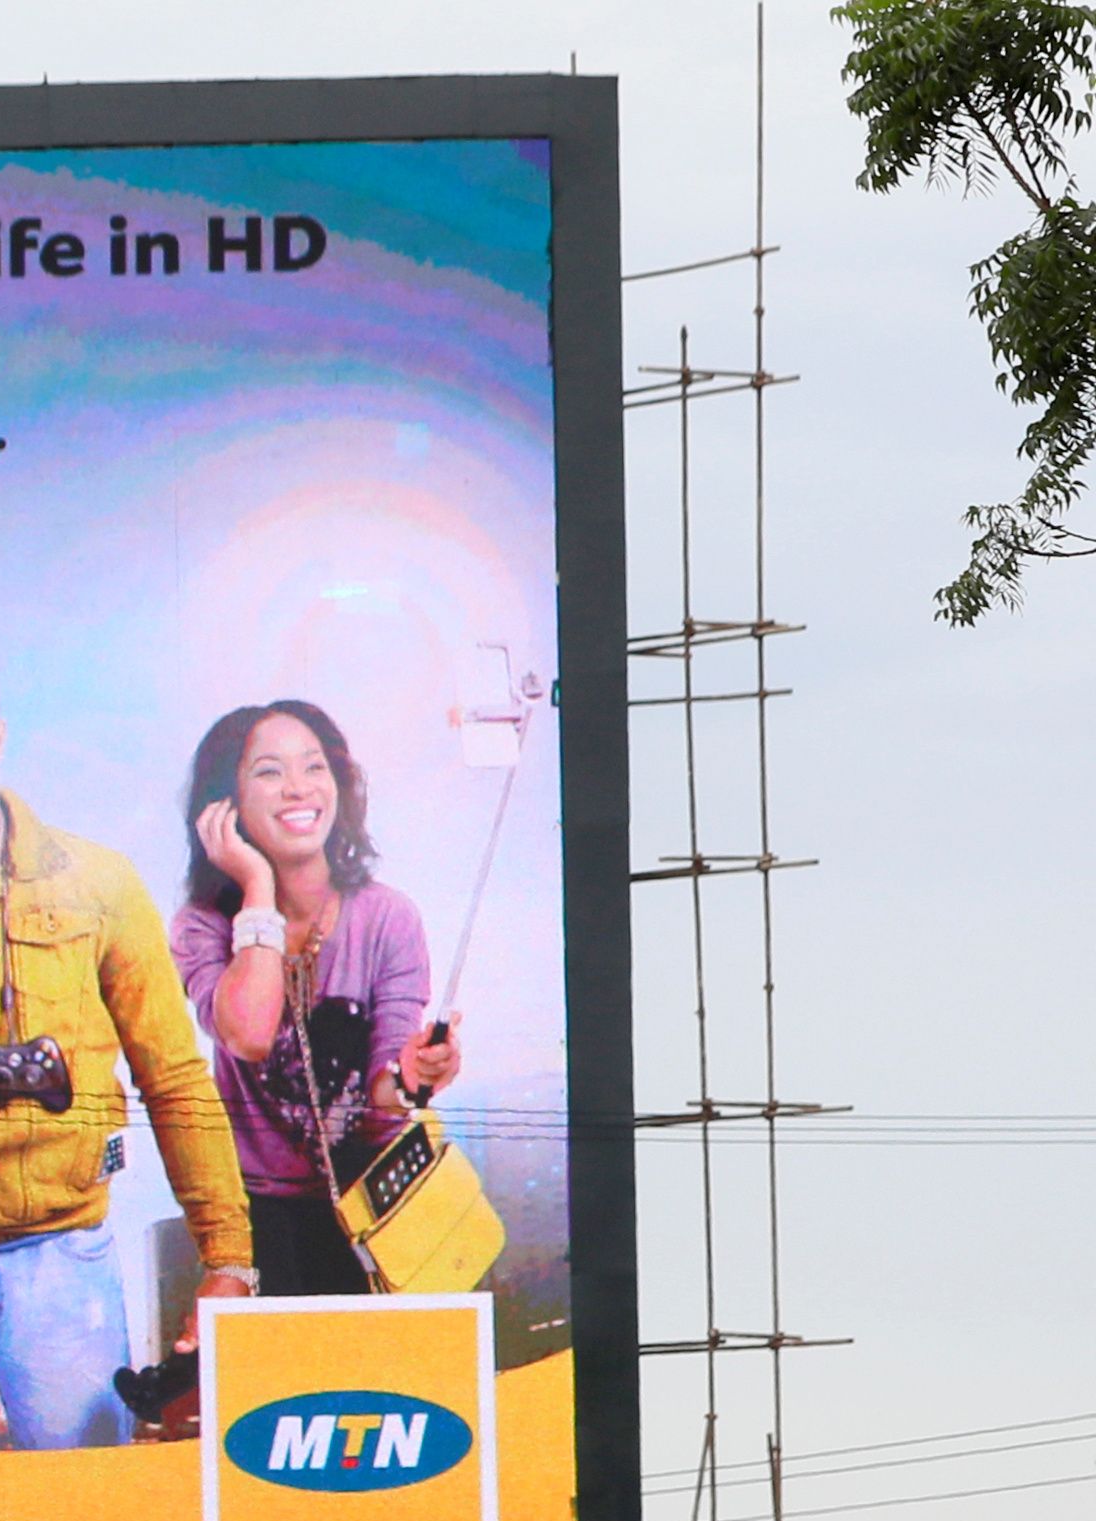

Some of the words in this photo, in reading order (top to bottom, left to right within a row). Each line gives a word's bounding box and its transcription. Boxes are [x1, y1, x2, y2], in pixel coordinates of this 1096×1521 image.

[109, 215, 180, 276] in
[207, 215, 327, 273] HD
[267, 1413, 429, 1471] MTN
